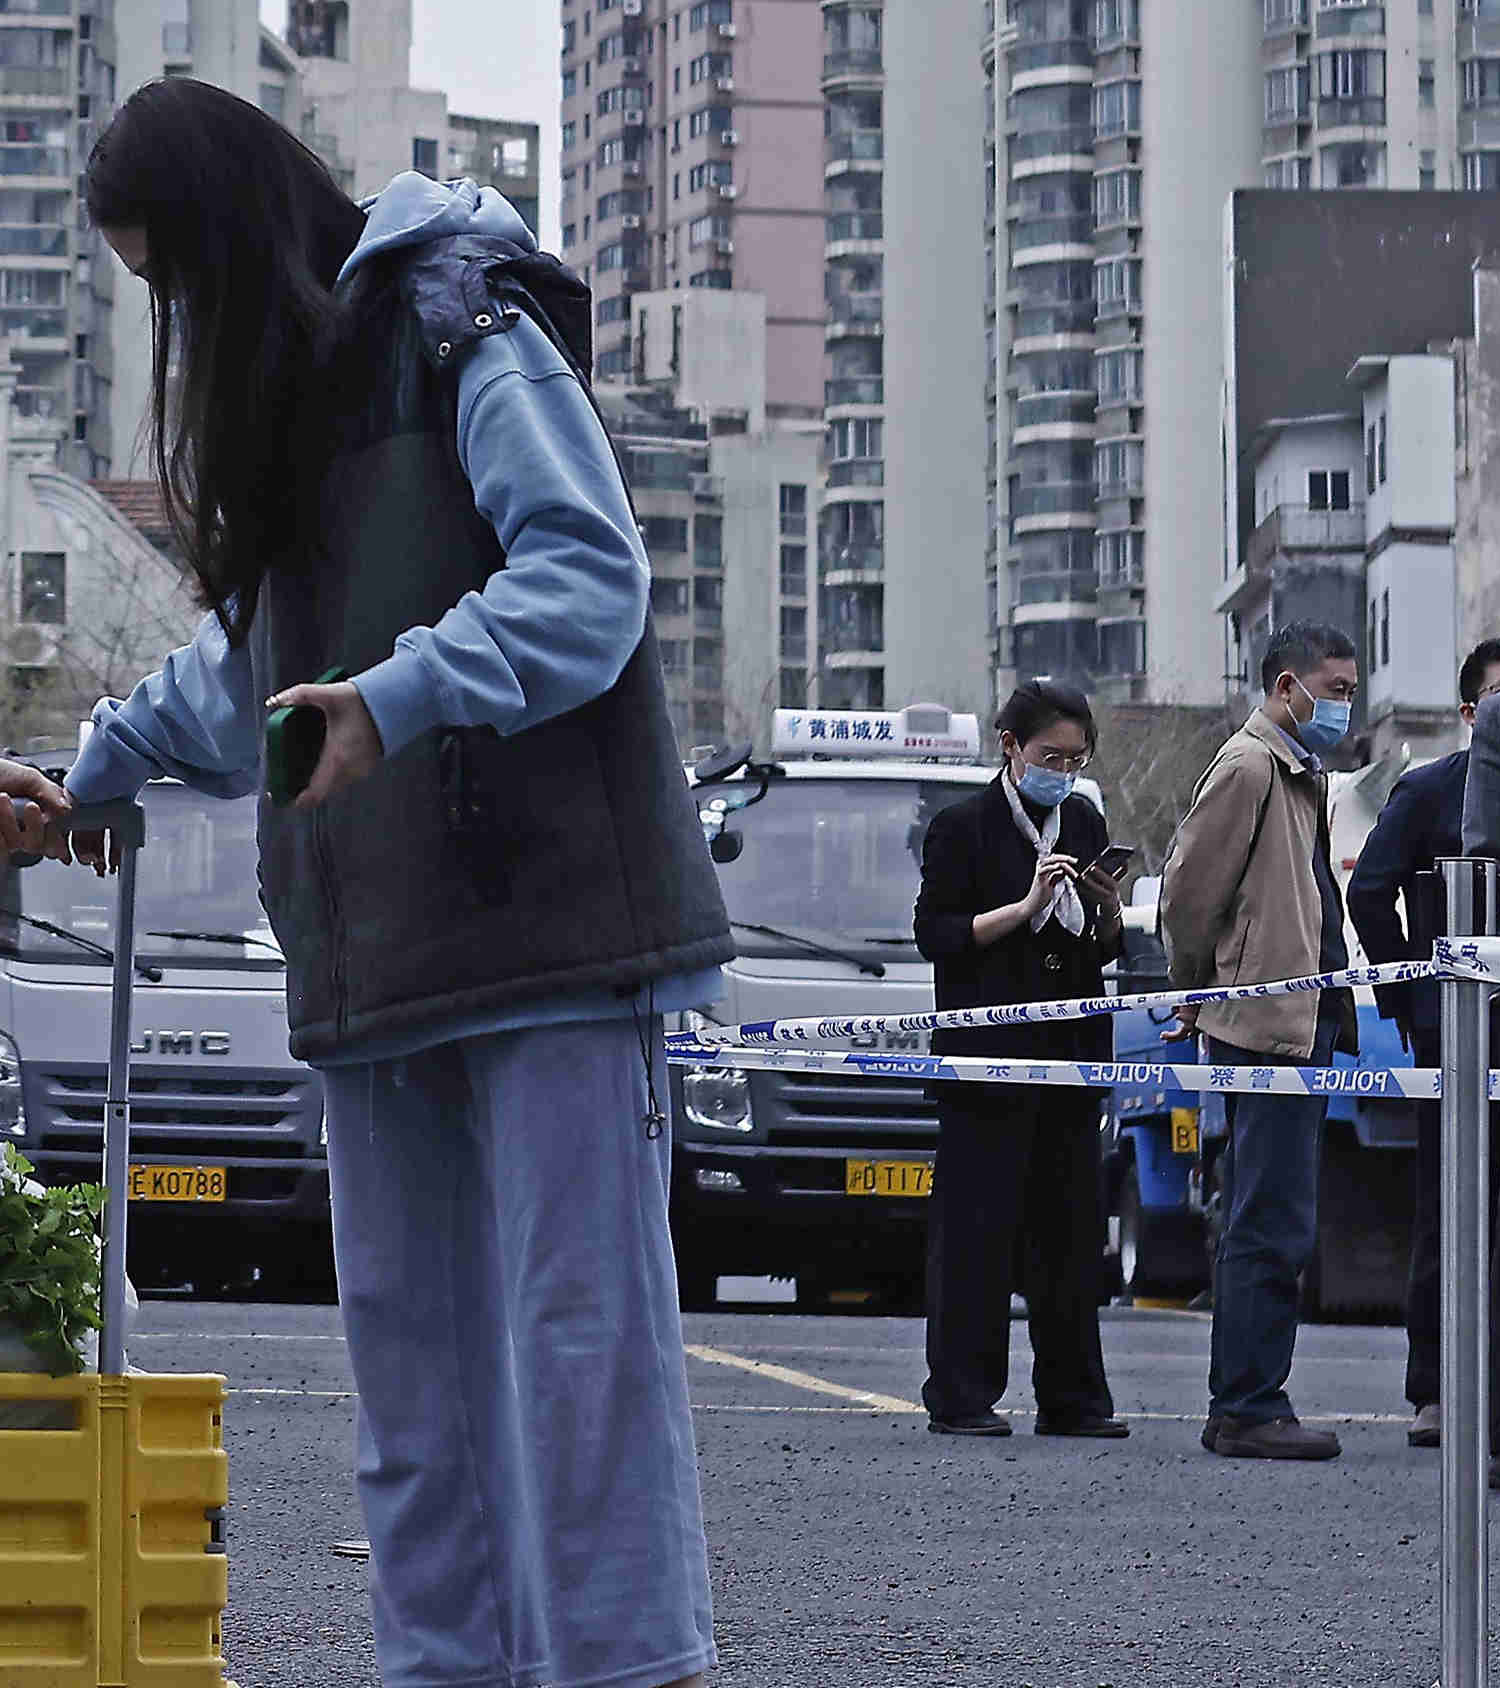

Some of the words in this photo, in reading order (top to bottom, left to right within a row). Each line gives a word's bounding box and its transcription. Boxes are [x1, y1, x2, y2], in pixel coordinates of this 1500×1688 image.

[808, 719, 895, 741] 黄浦城发
[130, 1030, 230, 1055] JMC
